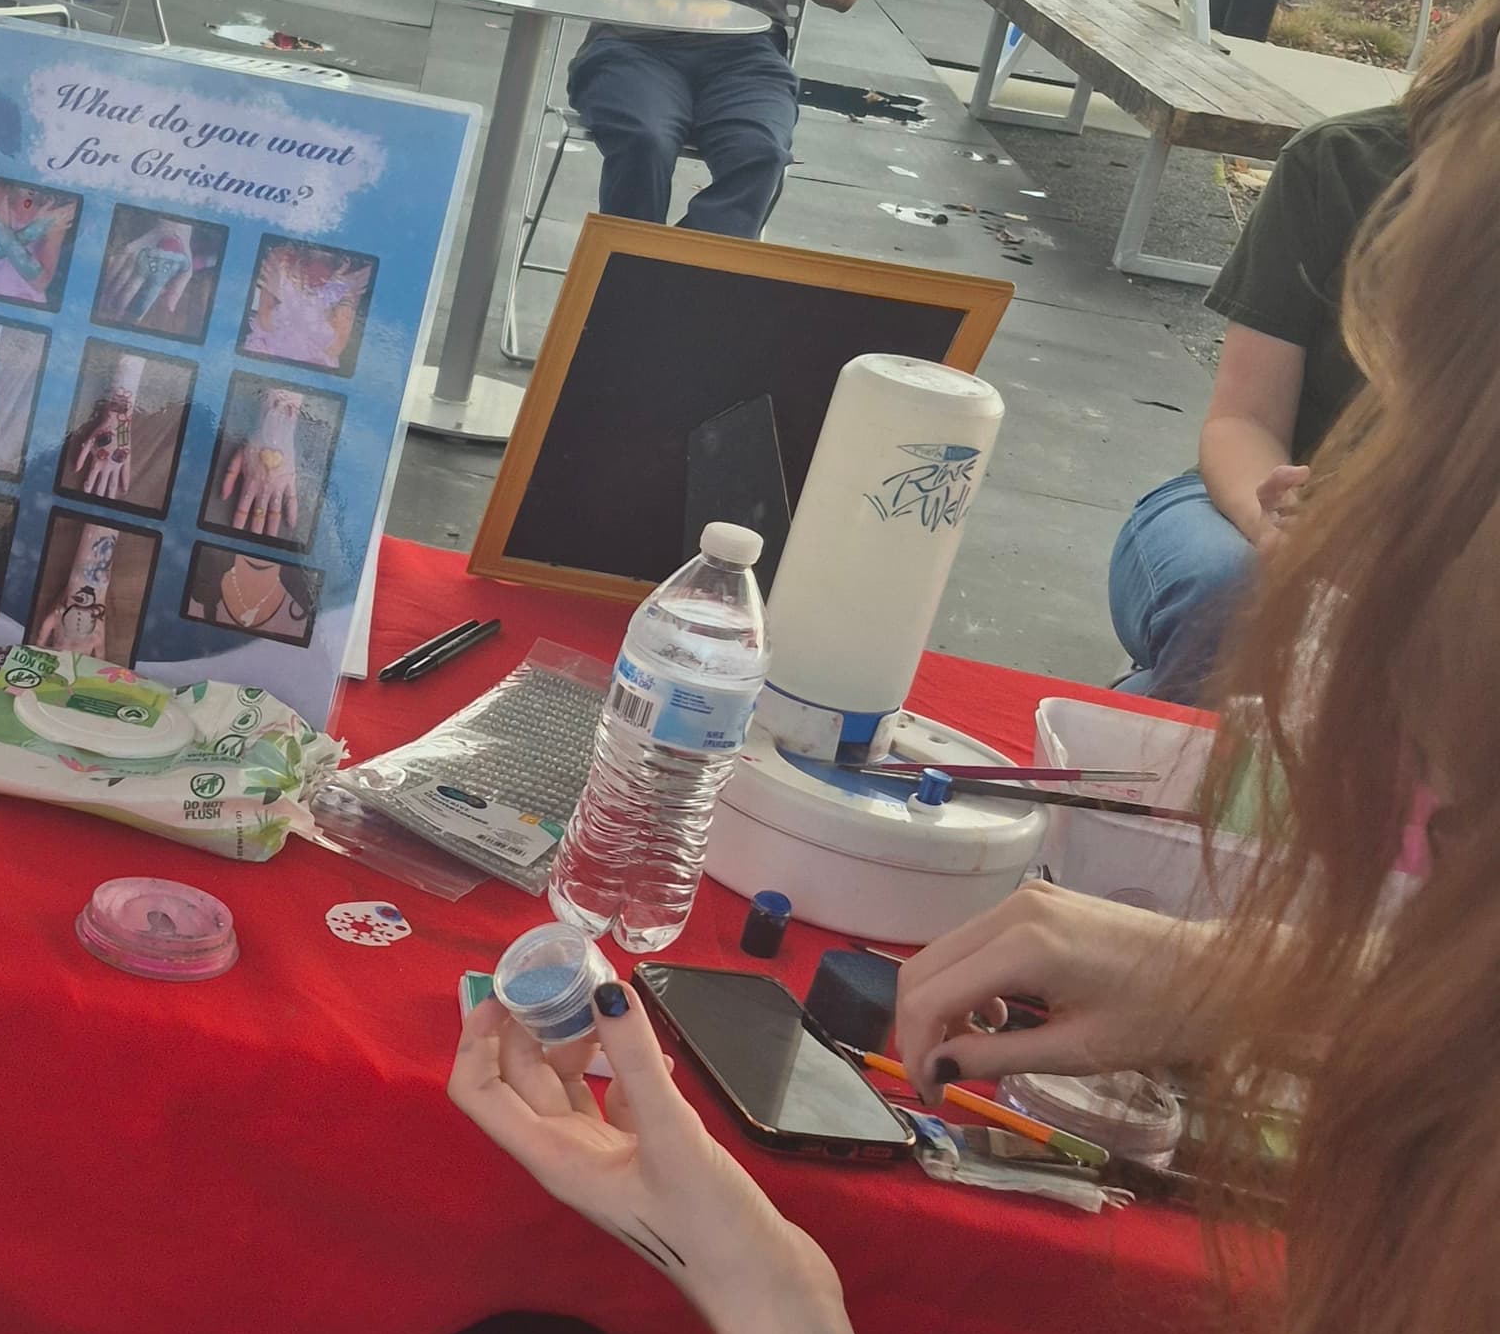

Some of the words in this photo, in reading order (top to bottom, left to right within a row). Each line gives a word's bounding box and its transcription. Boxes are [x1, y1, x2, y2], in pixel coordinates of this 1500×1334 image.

[57, 83, 143, 124] What
[149, 104, 192, 134] do
[183, 121, 260, 149] you
[267, 136, 357, 166] want
[47, 136, 120, 169] for
[130, 147, 314, 206] Christmas?
[183, 800, 200, 810] DO
[184, 808, 221, 820] FLUSH
